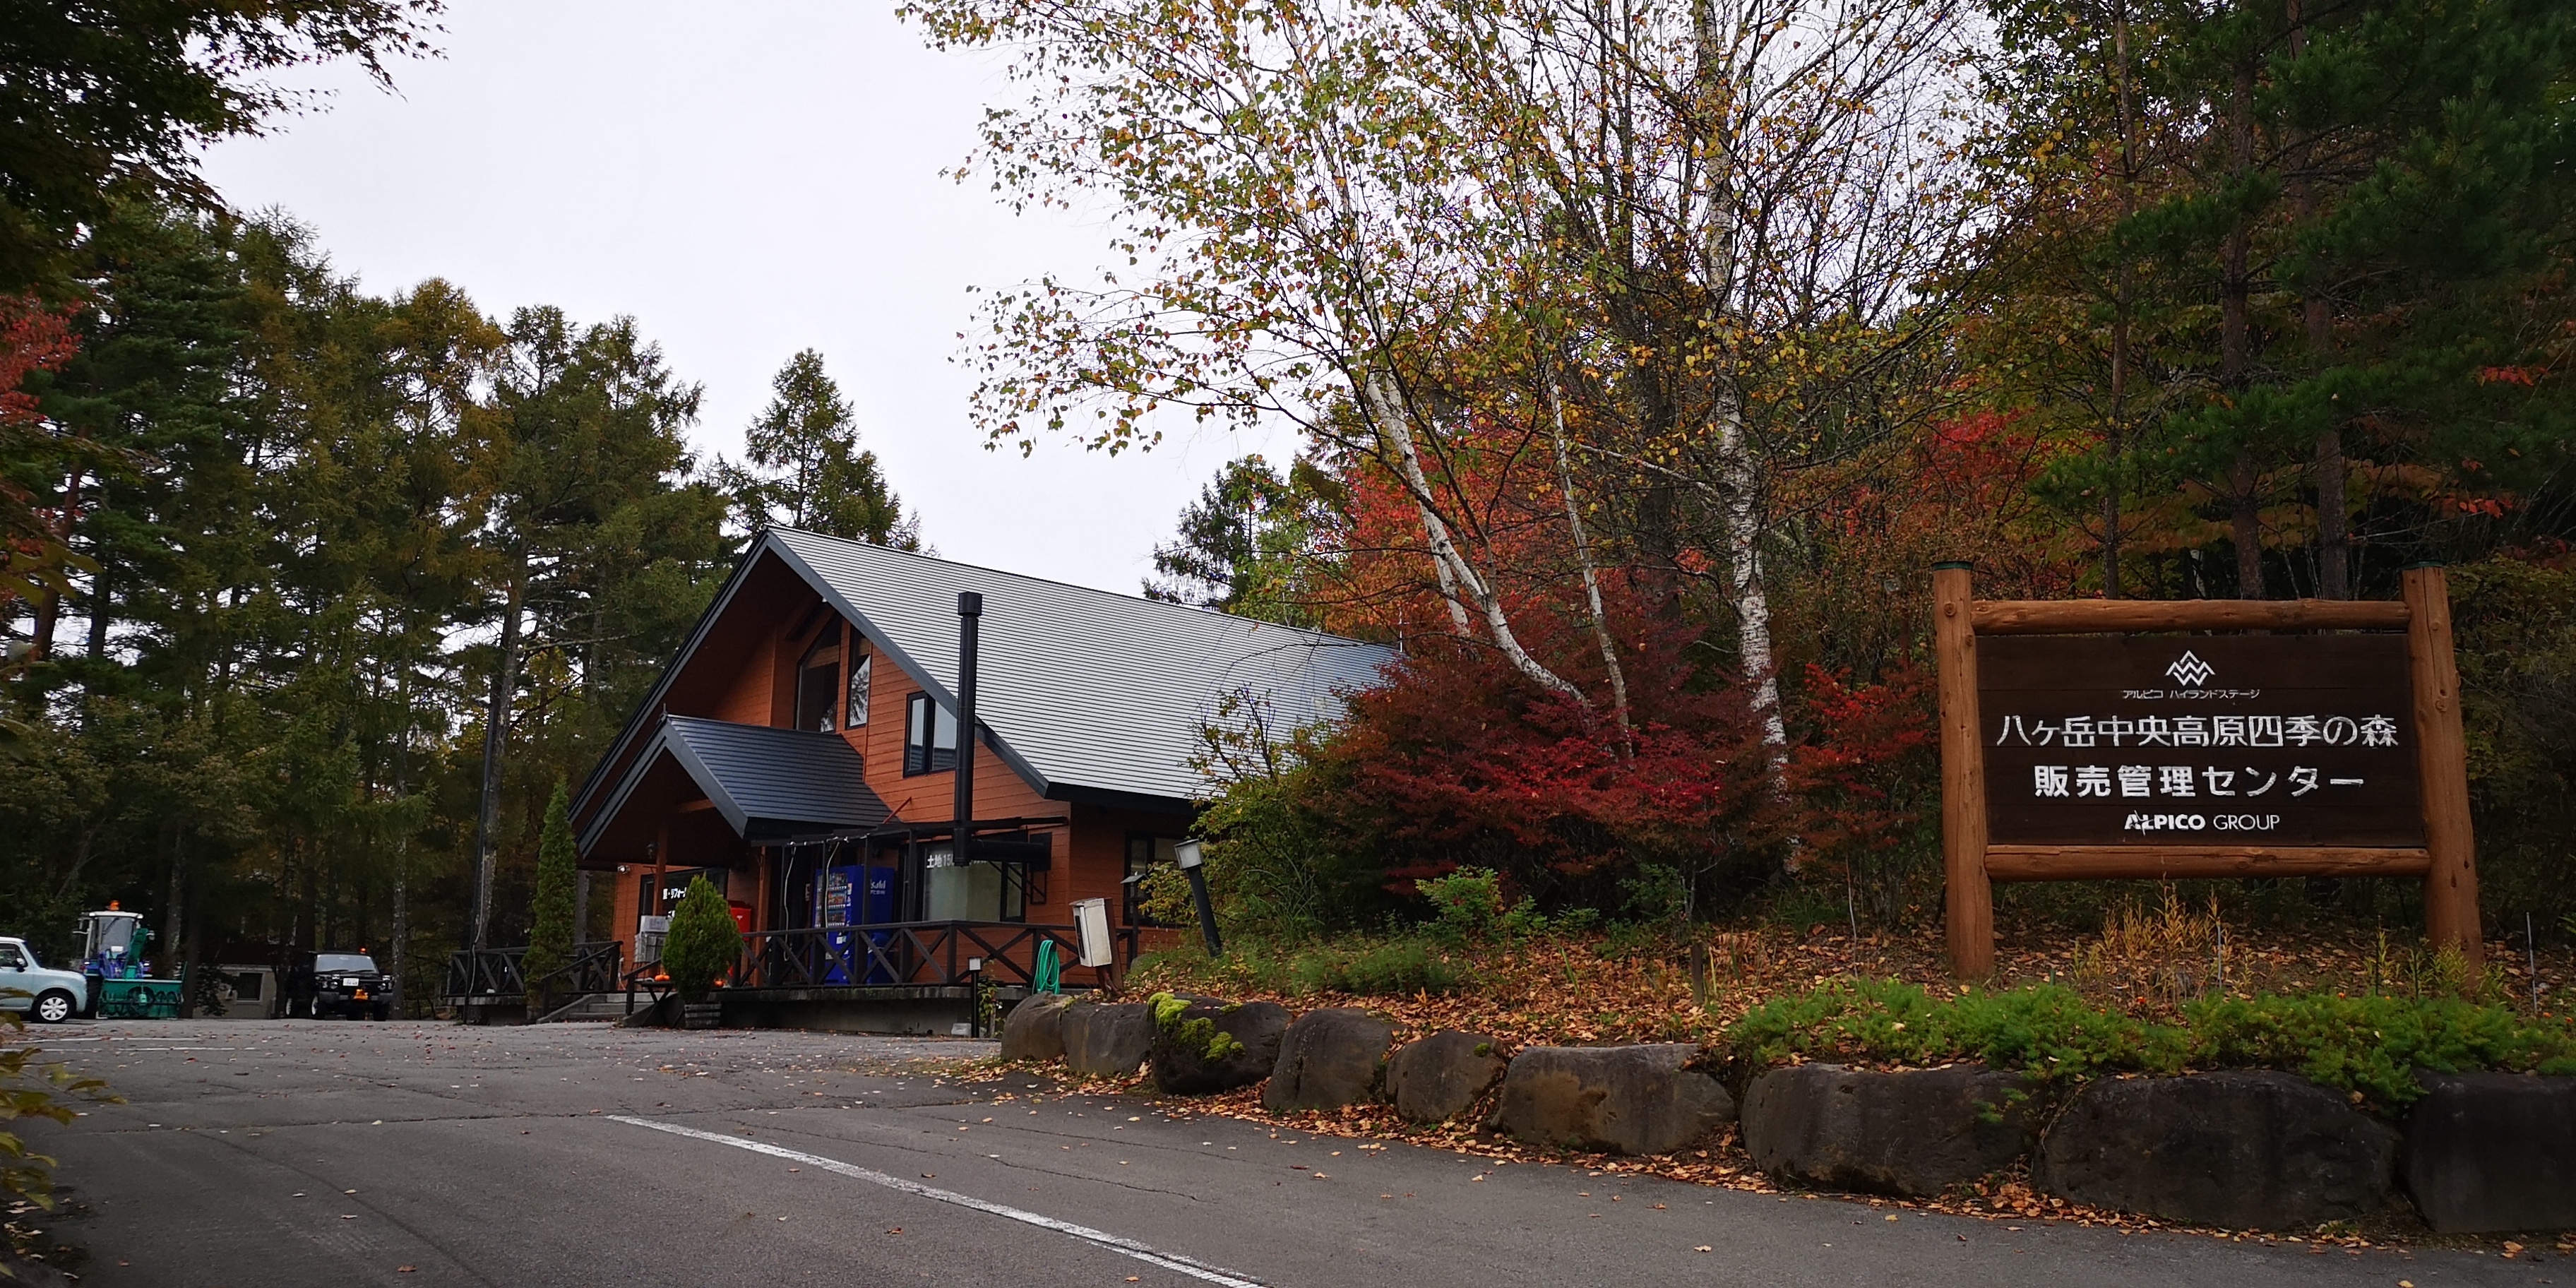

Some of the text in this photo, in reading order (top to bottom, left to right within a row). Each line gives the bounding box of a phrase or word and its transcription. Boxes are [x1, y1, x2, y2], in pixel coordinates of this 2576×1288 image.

[2123, 689, 2260, 699] アルピコ ハイランドステージ
[1997, 715, 2398, 746] 八ヶ岳中央高原四季の森
[2034, 765, 2363, 797] 販売管理センター
[2125, 810, 2279, 835] ALPICO GROUP
